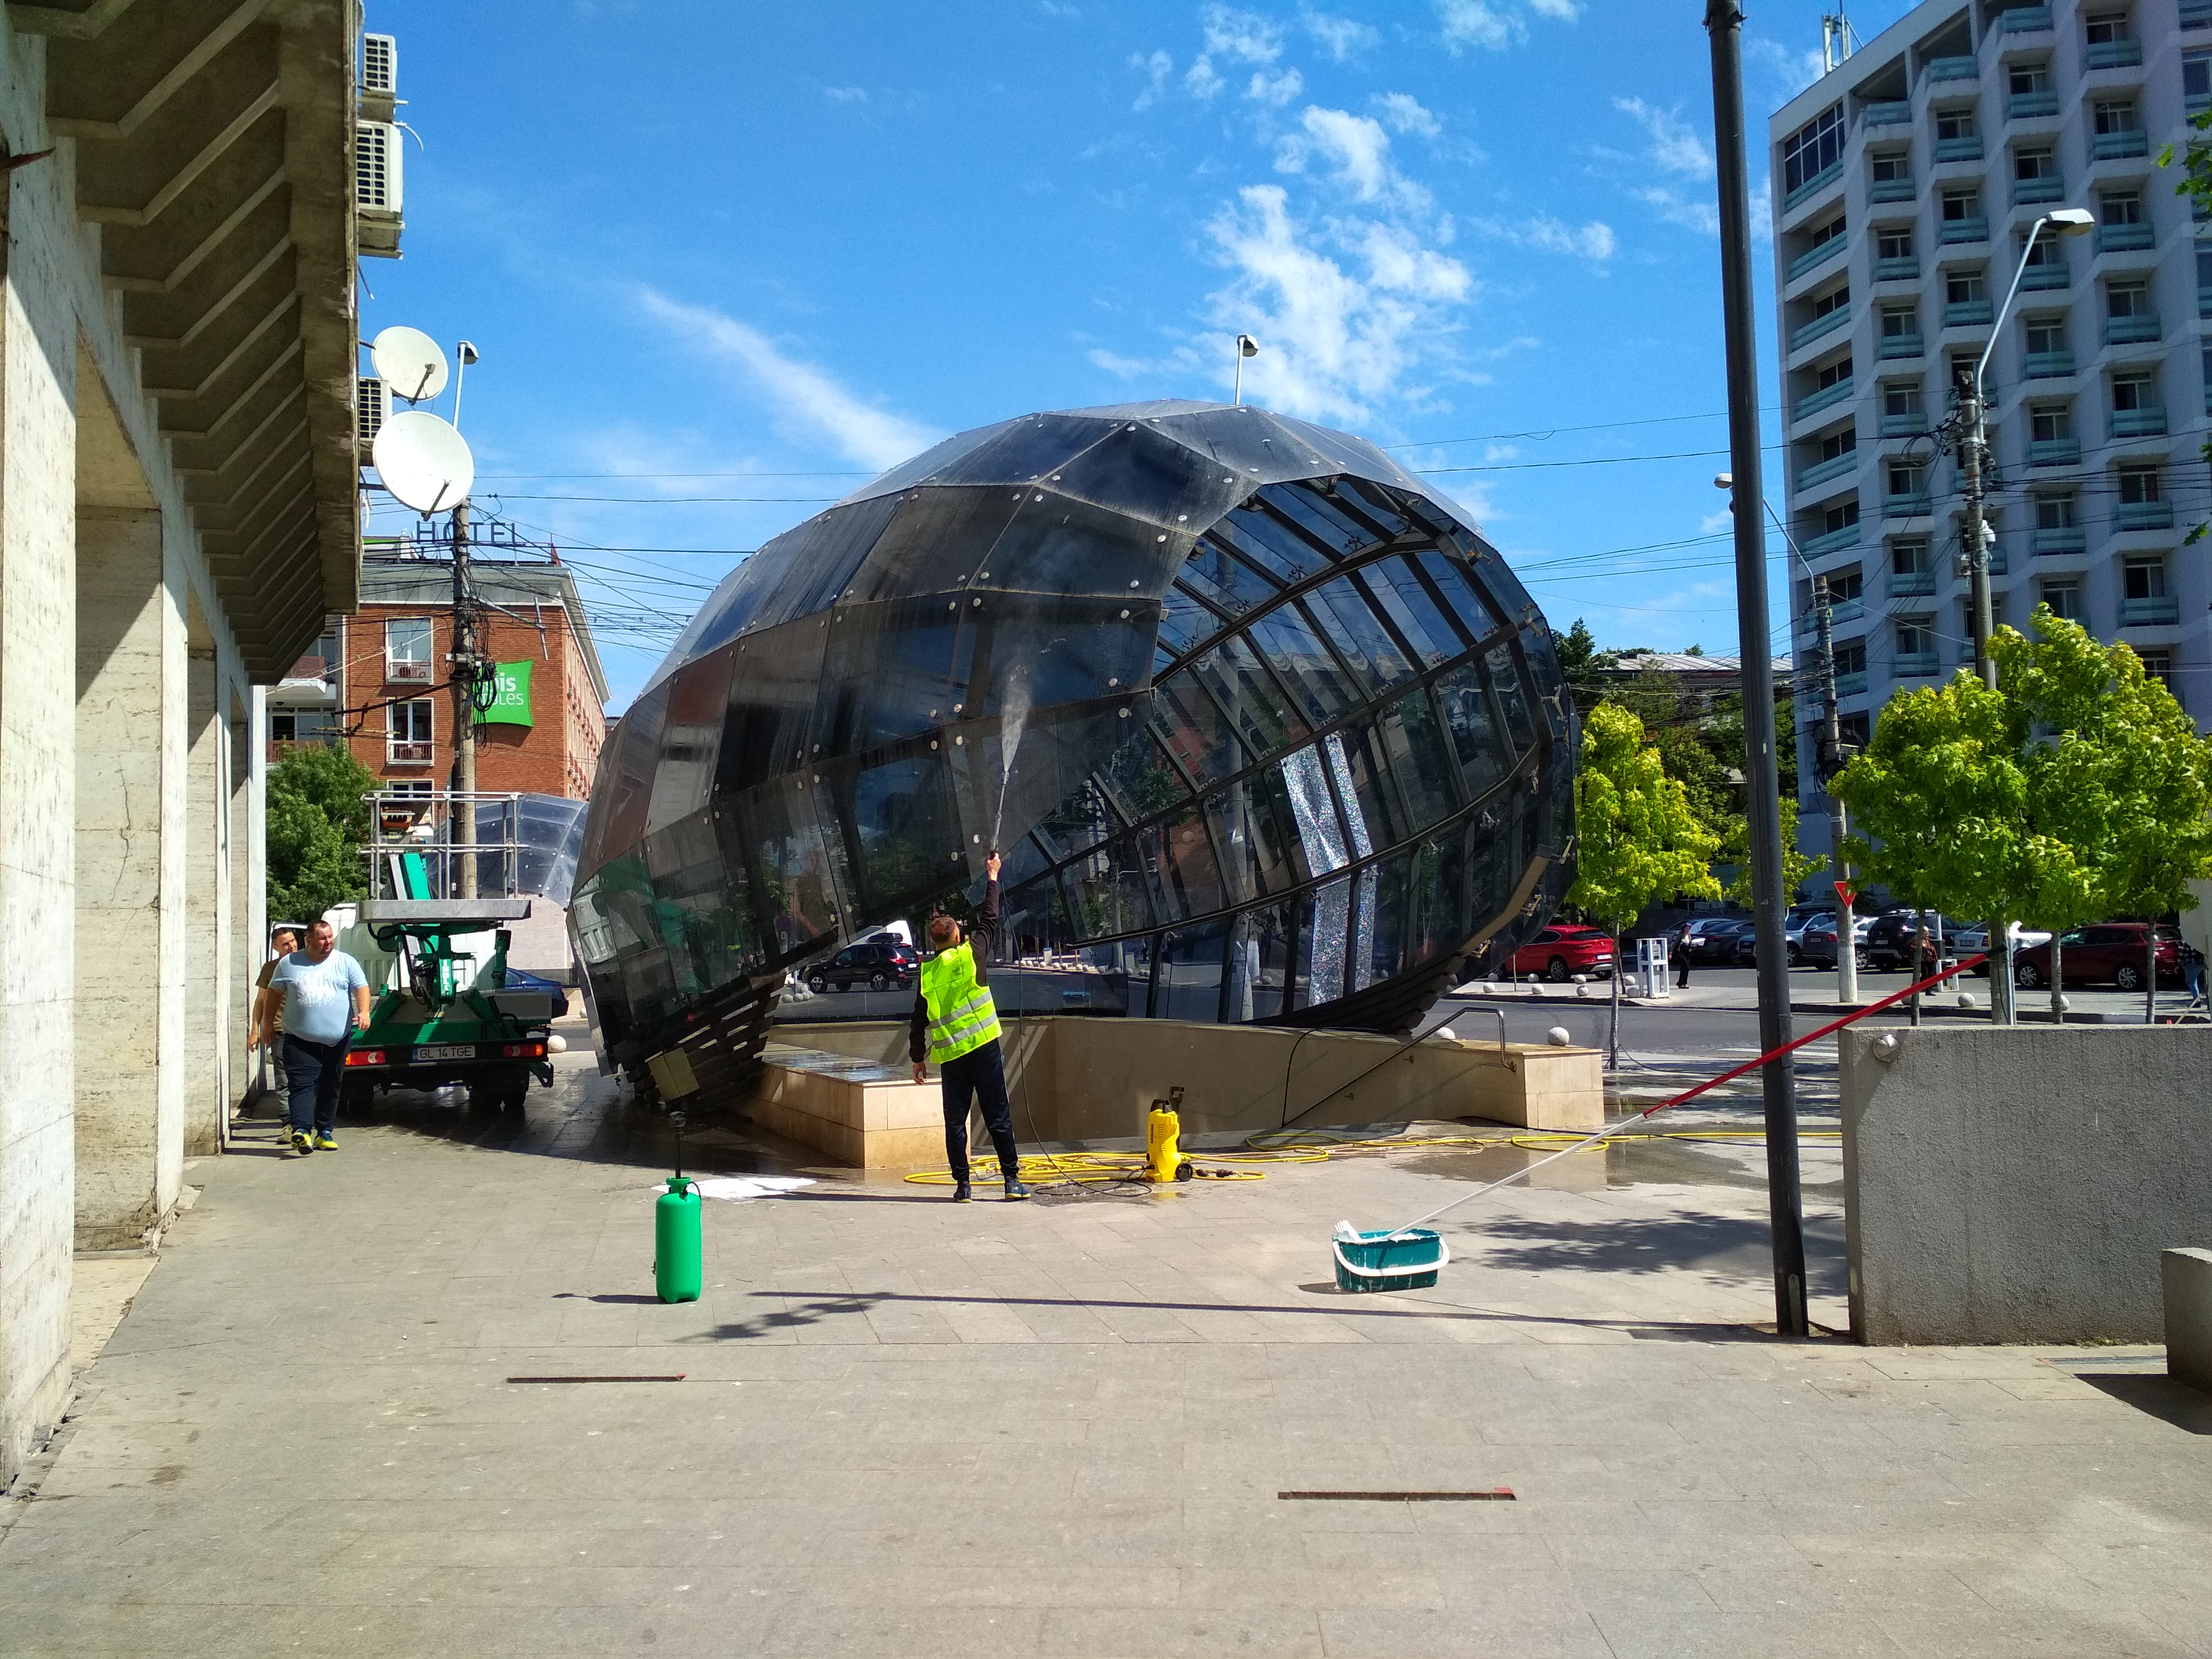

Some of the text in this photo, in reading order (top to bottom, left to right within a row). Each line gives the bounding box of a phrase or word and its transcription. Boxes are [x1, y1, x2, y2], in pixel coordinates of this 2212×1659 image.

[420, 1047, 471, 1059] GL 14 TGE
